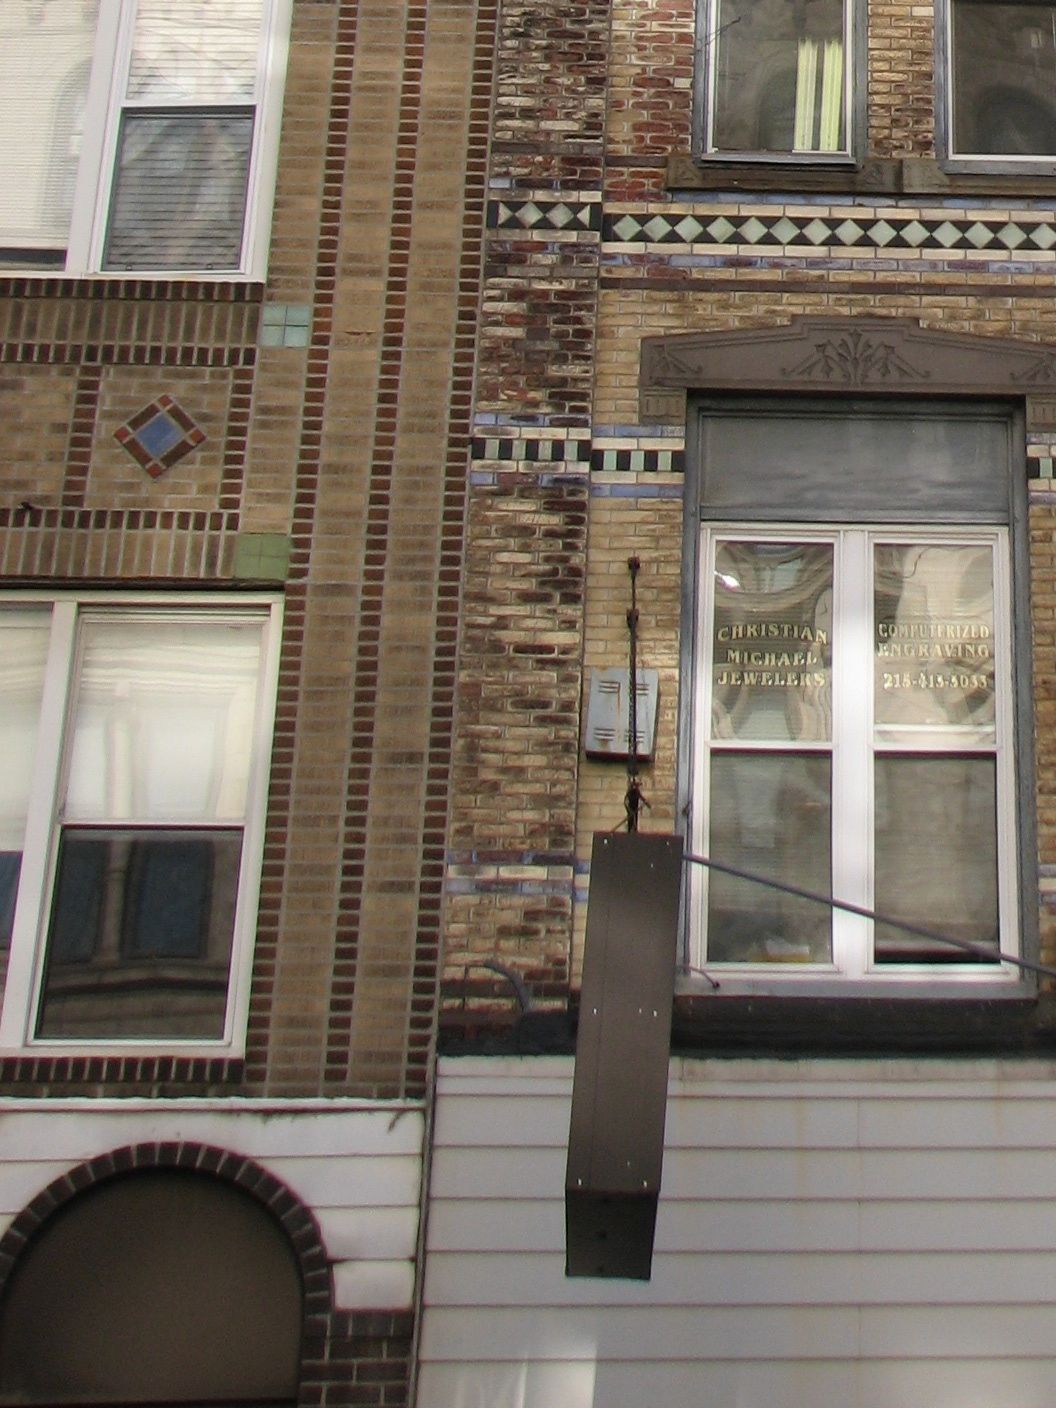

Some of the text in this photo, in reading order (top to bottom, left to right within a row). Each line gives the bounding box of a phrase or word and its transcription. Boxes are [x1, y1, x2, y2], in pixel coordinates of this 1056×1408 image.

[717, 623, 828, 645] CHRISTIAN
[878, 623, 990, 639] COMPUTERIZED
[727, 648, 818, 668] MICHAEL
[877, 642, 990, 658] ENGRAVING
[717, 671, 826, 688] JEWELERS
